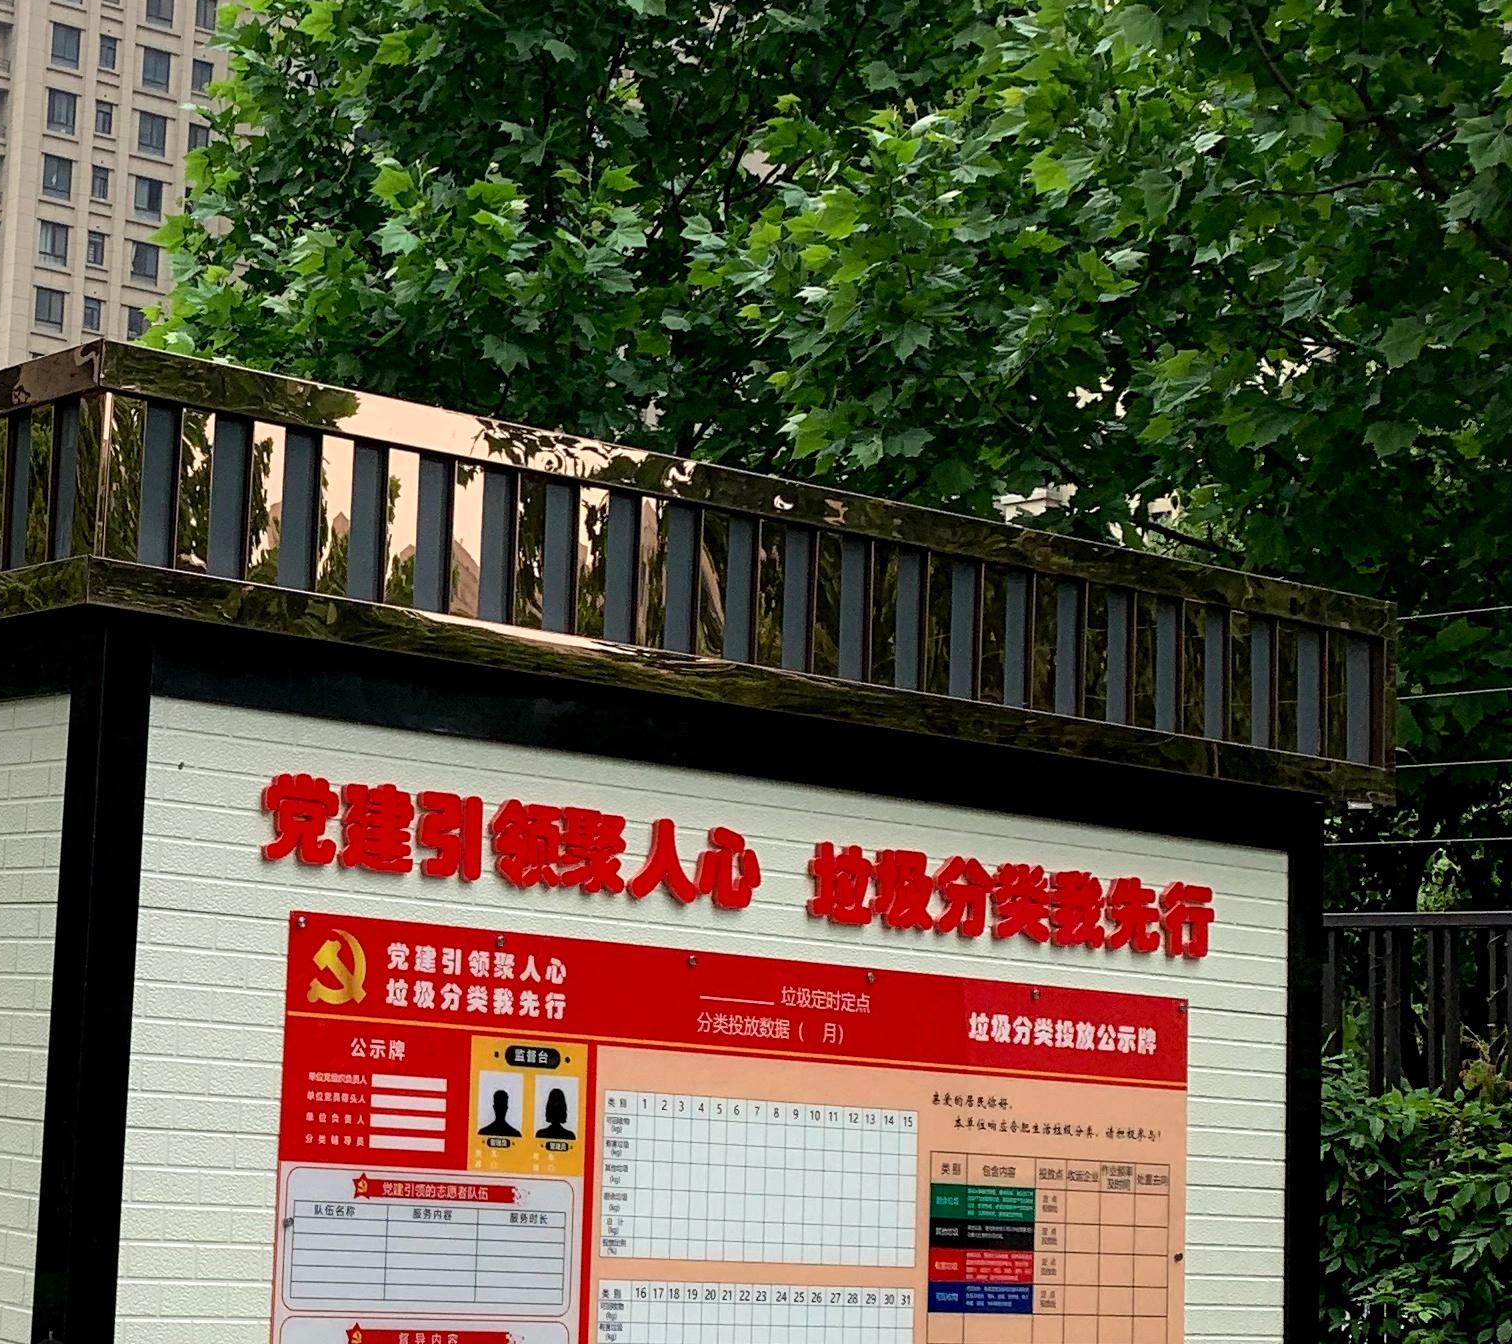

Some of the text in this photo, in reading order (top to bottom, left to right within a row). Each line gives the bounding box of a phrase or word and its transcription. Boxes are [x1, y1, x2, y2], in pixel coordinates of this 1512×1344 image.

[261, 773, 1215, 958] 党建引领聚人心 垃圾分类我先行
[387, 942, 567, 985] 党建引领聚人心
[386, 977, 567, 1020] 垃圾分类我先行
[781, 985, 871, 1013] 垃圾定时定点
[968, 1012, 1157, 1055] 垃圾分类投放公示牌
[350, 1038, 406, 1062] 公示牌
[514, 1048, 549, 1065] 监督台
[643, 1098, 647, 1109] 1
[661, 1099, 668, 1111] 2
[678, 1100, 685, 1112] 3
[698, 1102, 704, 1113] 4
[716, 1103, 723, 1115] 5
[734, 1104, 740, 1116] 6
[754, 1106, 761, 1116] 7
[773, 1107, 779, 1118] 8
[793, 1108, 799, 1120] 9
[810, 1110, 821, 1121] 10
[828, 1111, 838, 1122] 11
[849, 1112, 859, 1124] 12
[865, 1113, 876, 1125] 13
[883, 1115, 894, 1126] 14
[903, 1116, 913, 1127] 15
[382, 1182, 488, 1201] 党建引领的志愿者队伍
[314, 1204, 355, 1217] 队伍名称
[412, 1208, 453, 1221] 服务内容
[509, 1212, 548, 1225] 服务时长
[635, 1287, 647, 1299] 16
[653, 1288, 664, 1299] 17
[669, 1288, 680, 1300] 18
[687, 1289, 698, 1300] 19
[704, 1289, 717, 1301] 20
[722, 1290, 733, 1301] 21
[738, 1290, 751, 1302] 22
[755, 1291, 767, 1302] 23
[775, 1291, 787, 1302] 24
[793, 1291, 805, 1303] 25
[811, 1292, 822, 1303] 26
[830, 1292, 841, 1304] 27
[847, 1293, 858, 1304] 28
[865, 1293, 877, 1305] 29
[883, 1294, 895, 1305] 30
[901, 1294, 911, 1305] 31
